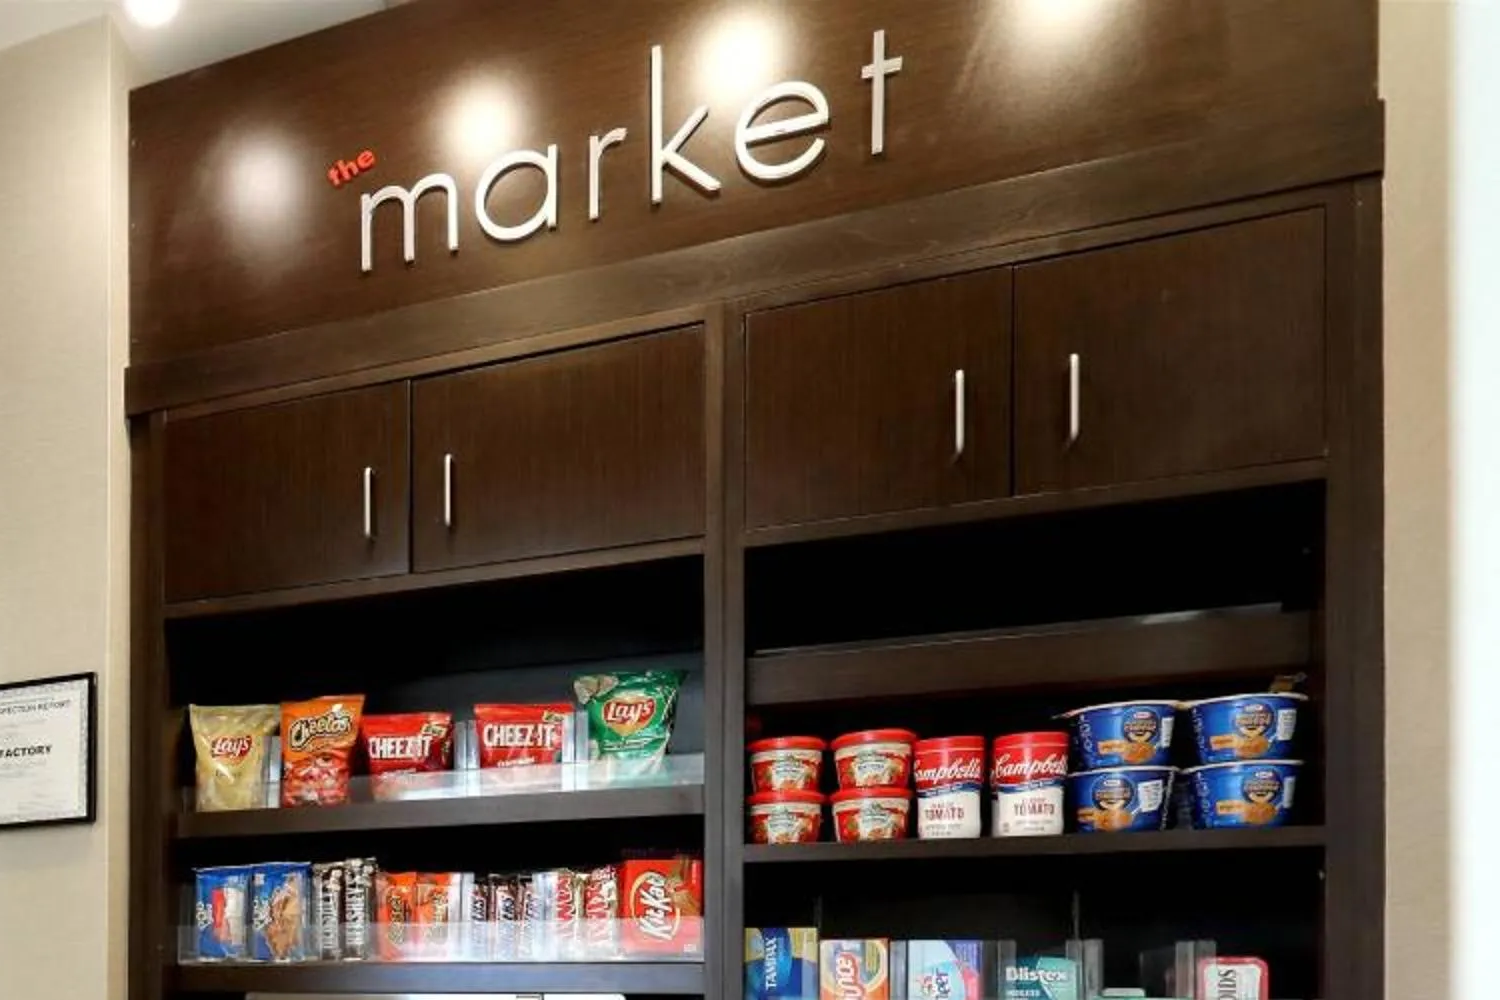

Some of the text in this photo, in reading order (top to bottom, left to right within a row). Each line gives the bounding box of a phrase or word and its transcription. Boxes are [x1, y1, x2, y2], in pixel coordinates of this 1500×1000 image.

[326, 147, 376, 188] the
[360, 28, 903, 274] market
[290, 714, 352, 749] Cheetos
[1013, 802, 1056, 816] TOMATO
[765, 936, 778, 991] TAMPAX
[1005, 966, 1067, 983] Blistex
